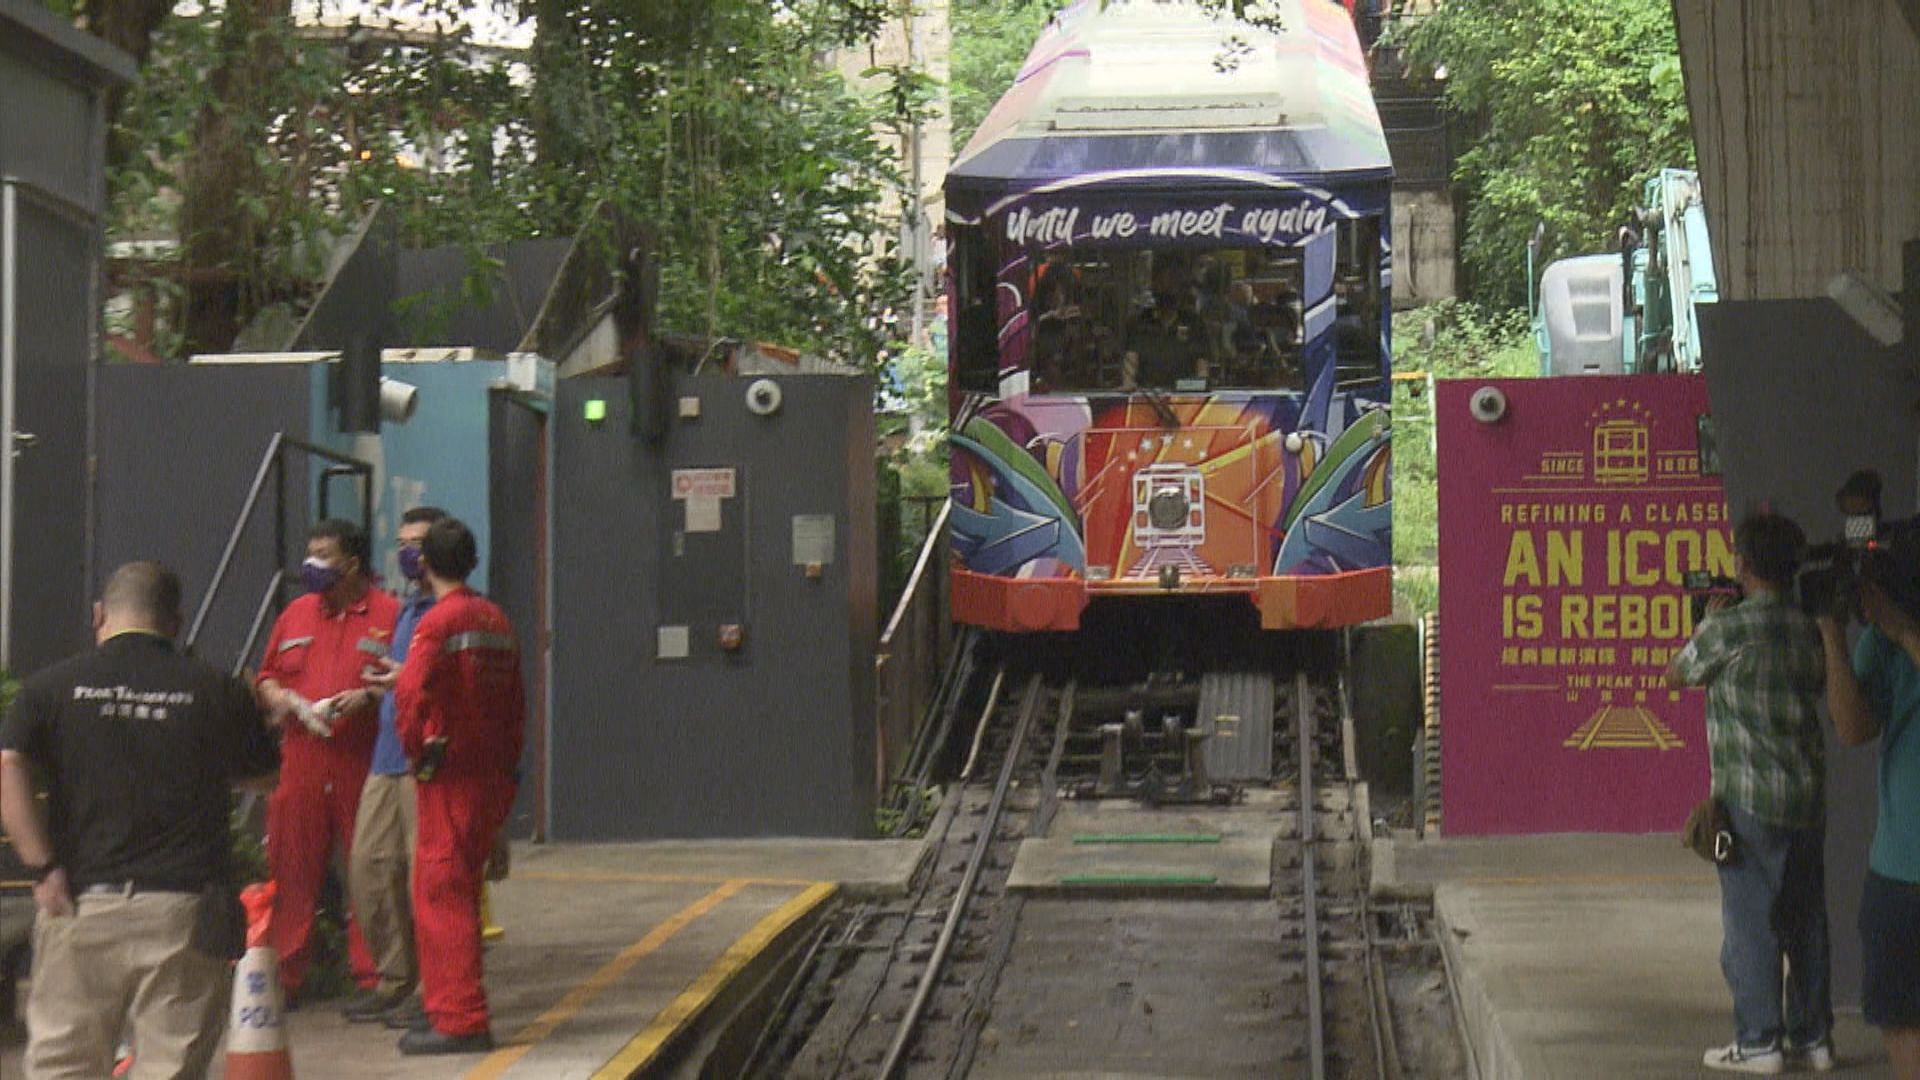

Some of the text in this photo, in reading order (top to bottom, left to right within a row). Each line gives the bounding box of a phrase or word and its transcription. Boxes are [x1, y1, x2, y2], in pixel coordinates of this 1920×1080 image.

[1006, 200, 1327, 245] Until we meet again
[1541, 458, 1585, 473] SINCE
[1501, 503, 1728, 524] REFINING A CLASSI
[1504, 529, 1737, 586] AN ICON
[1502, 593, 1693, 639] IS REBO
[1566, 676, 1667, 688] THE PEAK TRA
[240, 1006, 281, 1028] POL
